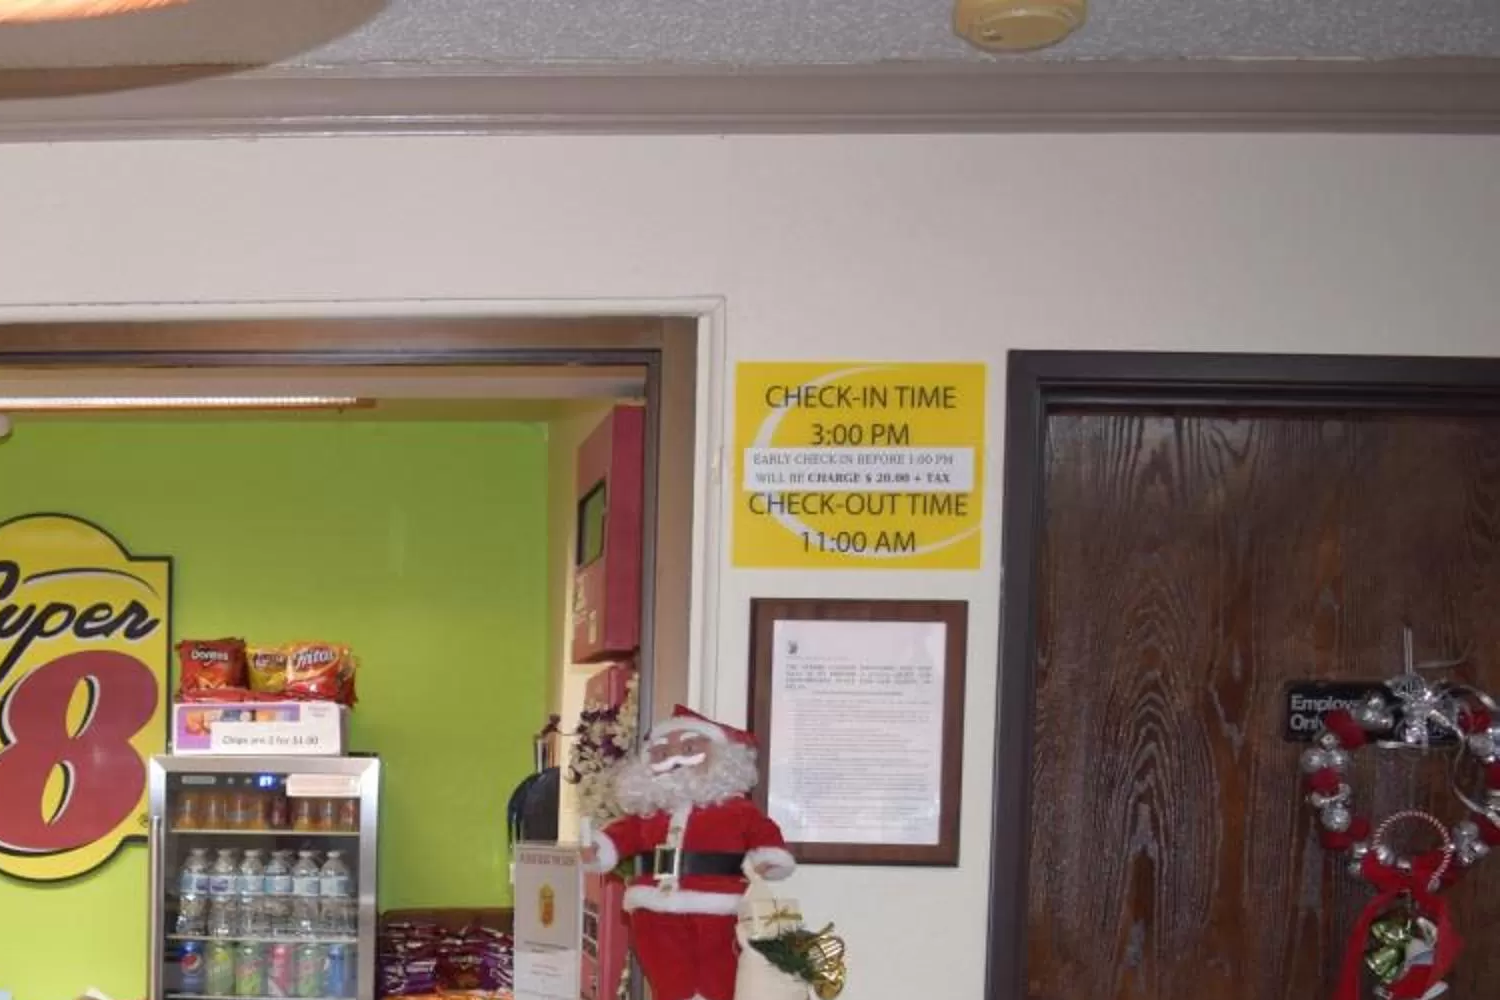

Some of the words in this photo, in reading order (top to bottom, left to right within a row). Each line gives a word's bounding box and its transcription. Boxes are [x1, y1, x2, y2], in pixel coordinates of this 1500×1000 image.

[765, 385, 888, 409] CHECK-IN
[894, 385, 957, 409] TIME
[811, 423, 863, 445] 3:00
[871, 423, 910, 445] PM
[753, 452, 790, 465] EARLY
[794, 452, 835, 466] CHECK
[857, 453, 905, 466] BEFORE
[934, 453, 954, 466] PM
[755, 472, 784, 485] WILL
[807, 471, 860, 485] CHARGE
[926, 471, 951, 485] TAX
[748, 493, 903, 517] CHECK-OUT
[907, 493, 969, 517] TIME
[802, 531, 867, 553] 11:00
[874, 531, 916, 553] AM
